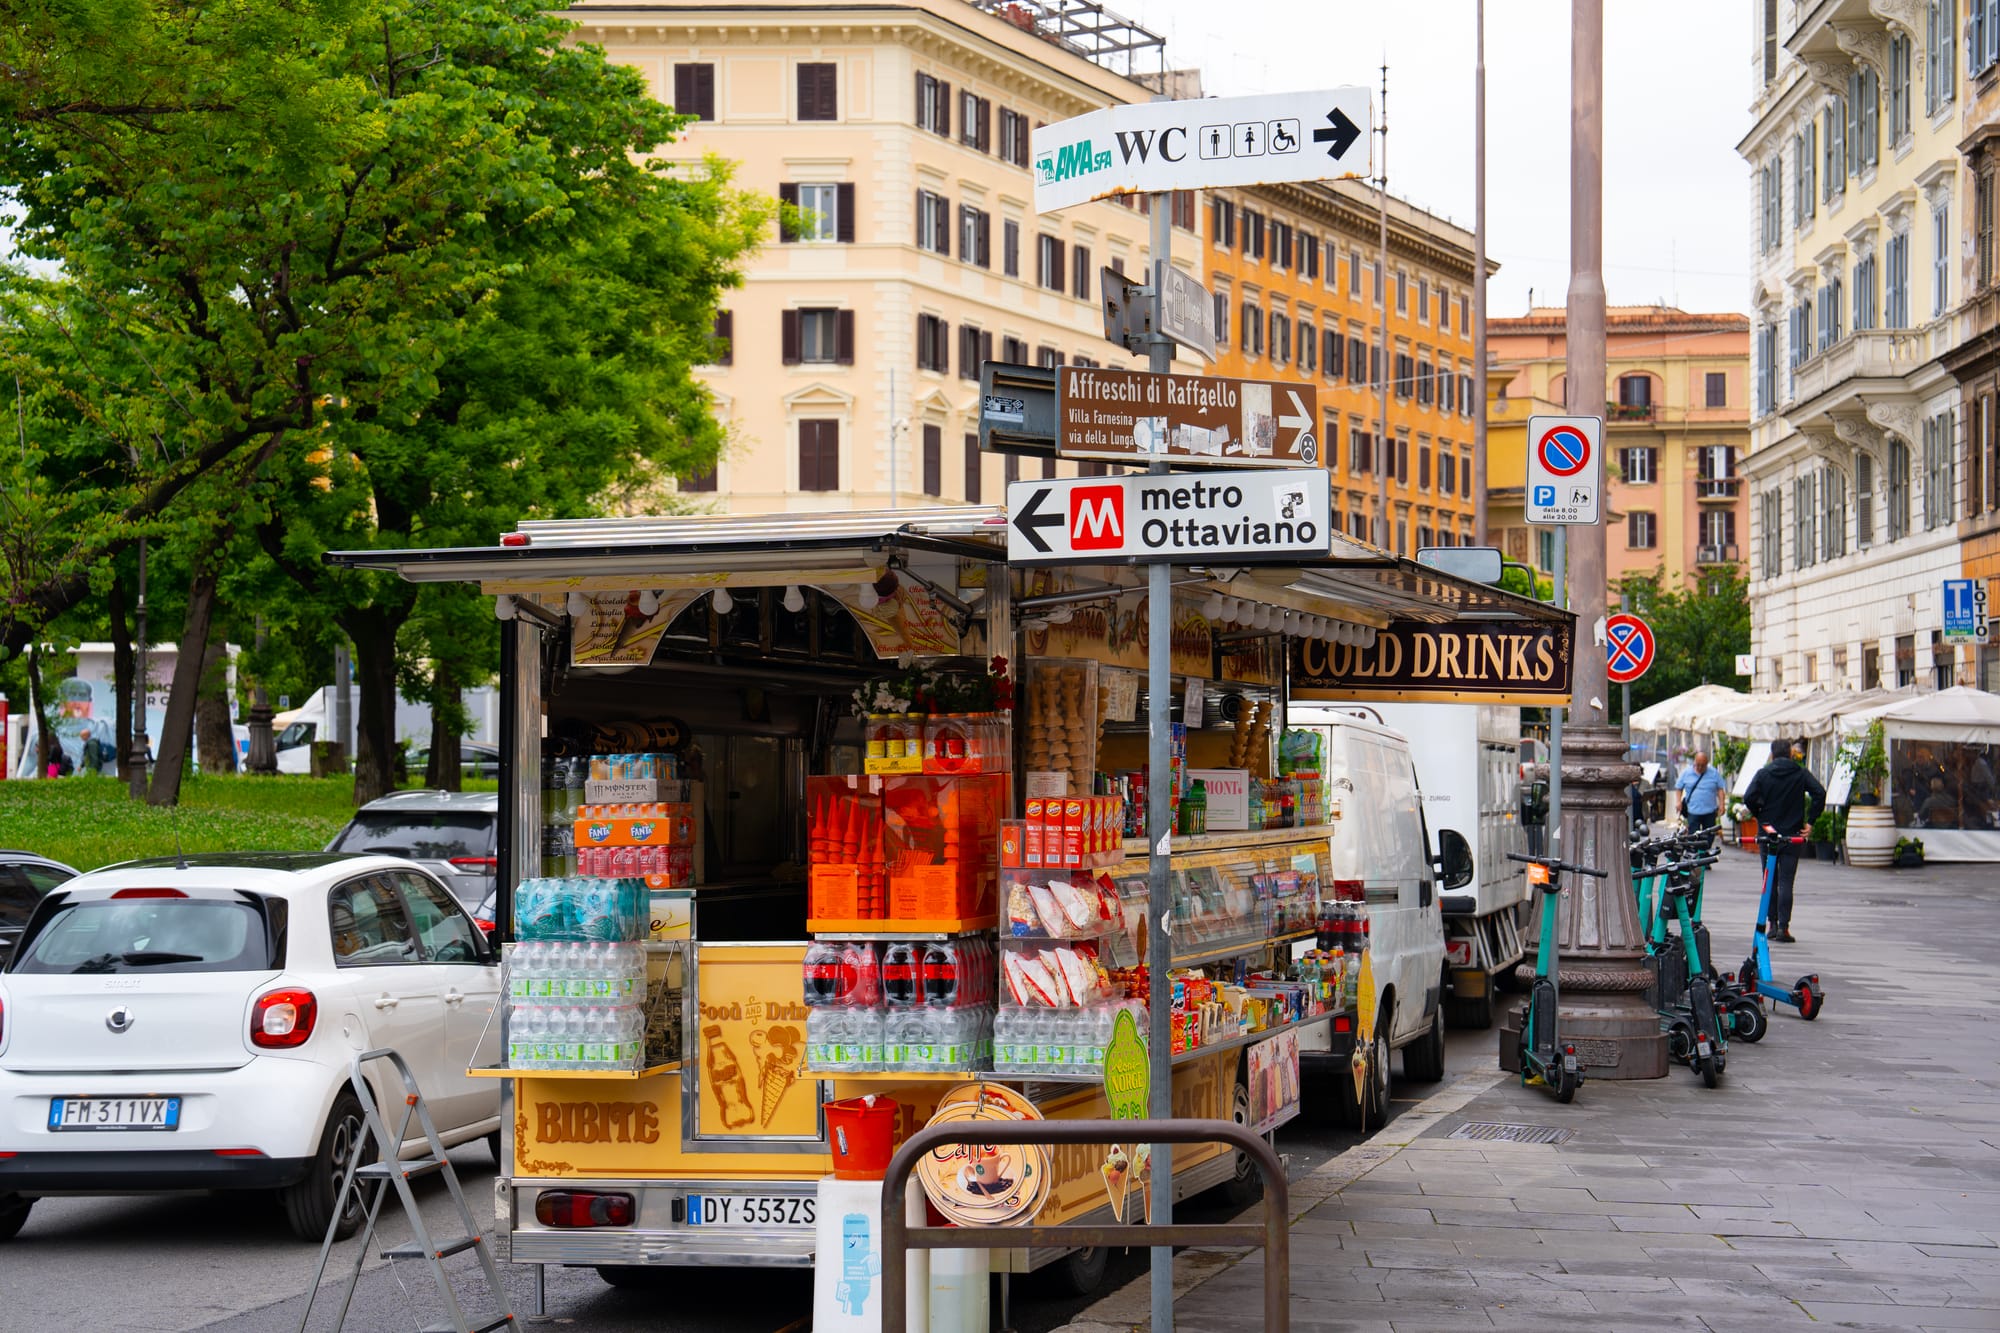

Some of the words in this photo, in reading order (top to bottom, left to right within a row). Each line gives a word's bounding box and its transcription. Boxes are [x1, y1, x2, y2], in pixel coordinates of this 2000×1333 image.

[1055, 139, 1093, 182] AMA
[1115, 126, 1187, 166] WC
[1068, 371, 1141, 403] Affreschi
[1147, 381, 1160, 404] di
[1167, 381, 1236, 408] Raffaello
[1069, 408, 1090, 423] Villa
[1093, 409, 1133, 426] Farnesina
[1069, 429, 1082, 444] via
[1085, 429, 1107, 445] della
[1110, 430, 1135, 448] Lunga
[1141, 480, 1243, 511] metro
[1141, 516, 1317, 548] Ottaviano
[1974, 579, 1988, 637] LOTTO
[1303, 632, 1402, 678] COLD
[1411, 633, 1555, 682] DRINKS
[604, 783, 648, 793] MONSTER
[765, 1001, 812, 1021] Drin
[64, 1101, 91, 1123] FM
[98, 1101, 166, 1123] 311VX
[535, 1101, 661, 1145] BIBITE
[704, 1198, 732, 1224] DY
[743, 1197, 816, 1225] 553ZS
